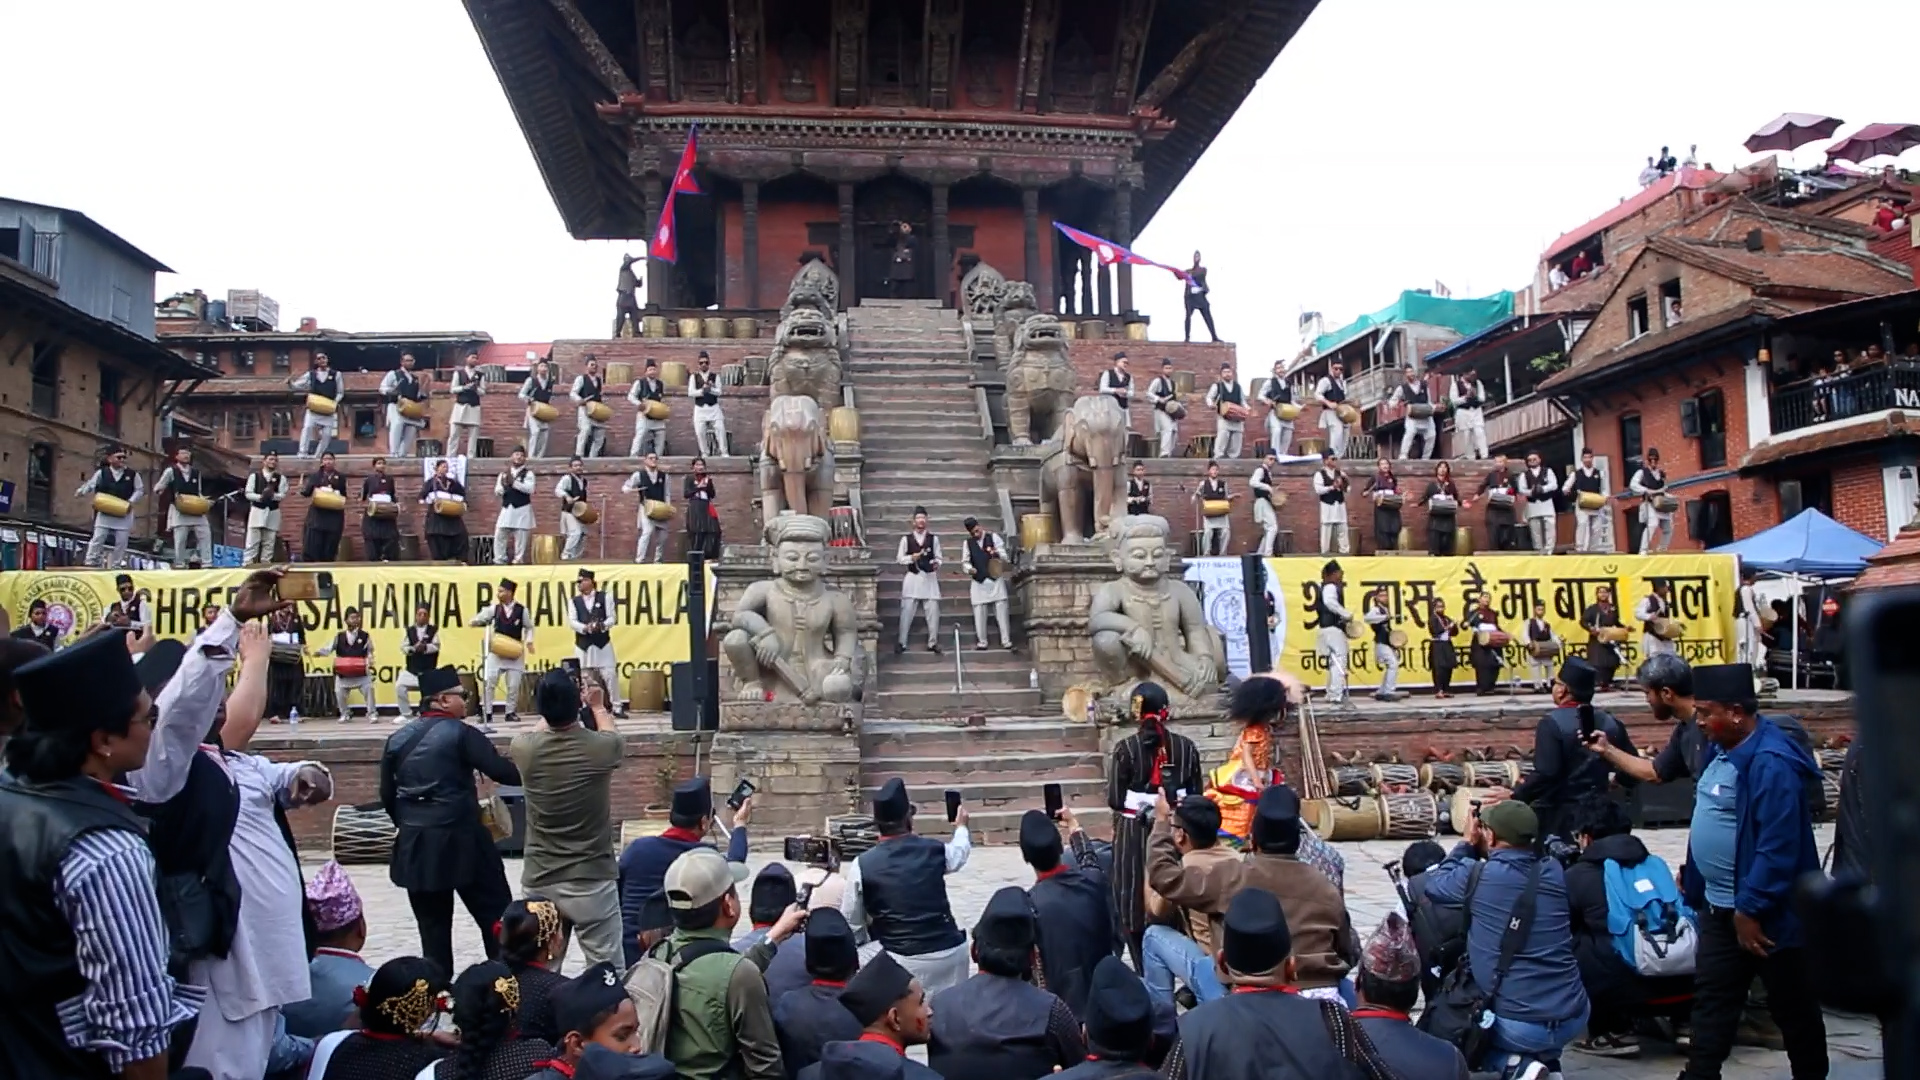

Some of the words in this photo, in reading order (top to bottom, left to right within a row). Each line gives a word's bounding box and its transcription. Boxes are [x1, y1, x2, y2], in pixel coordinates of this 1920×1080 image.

[1893, 387, 1920, 407] NA
[358, 582, 463, 629] HAIMA
[602, 579, 691, 626] HALA
[369, 664, 403, 684] ear
